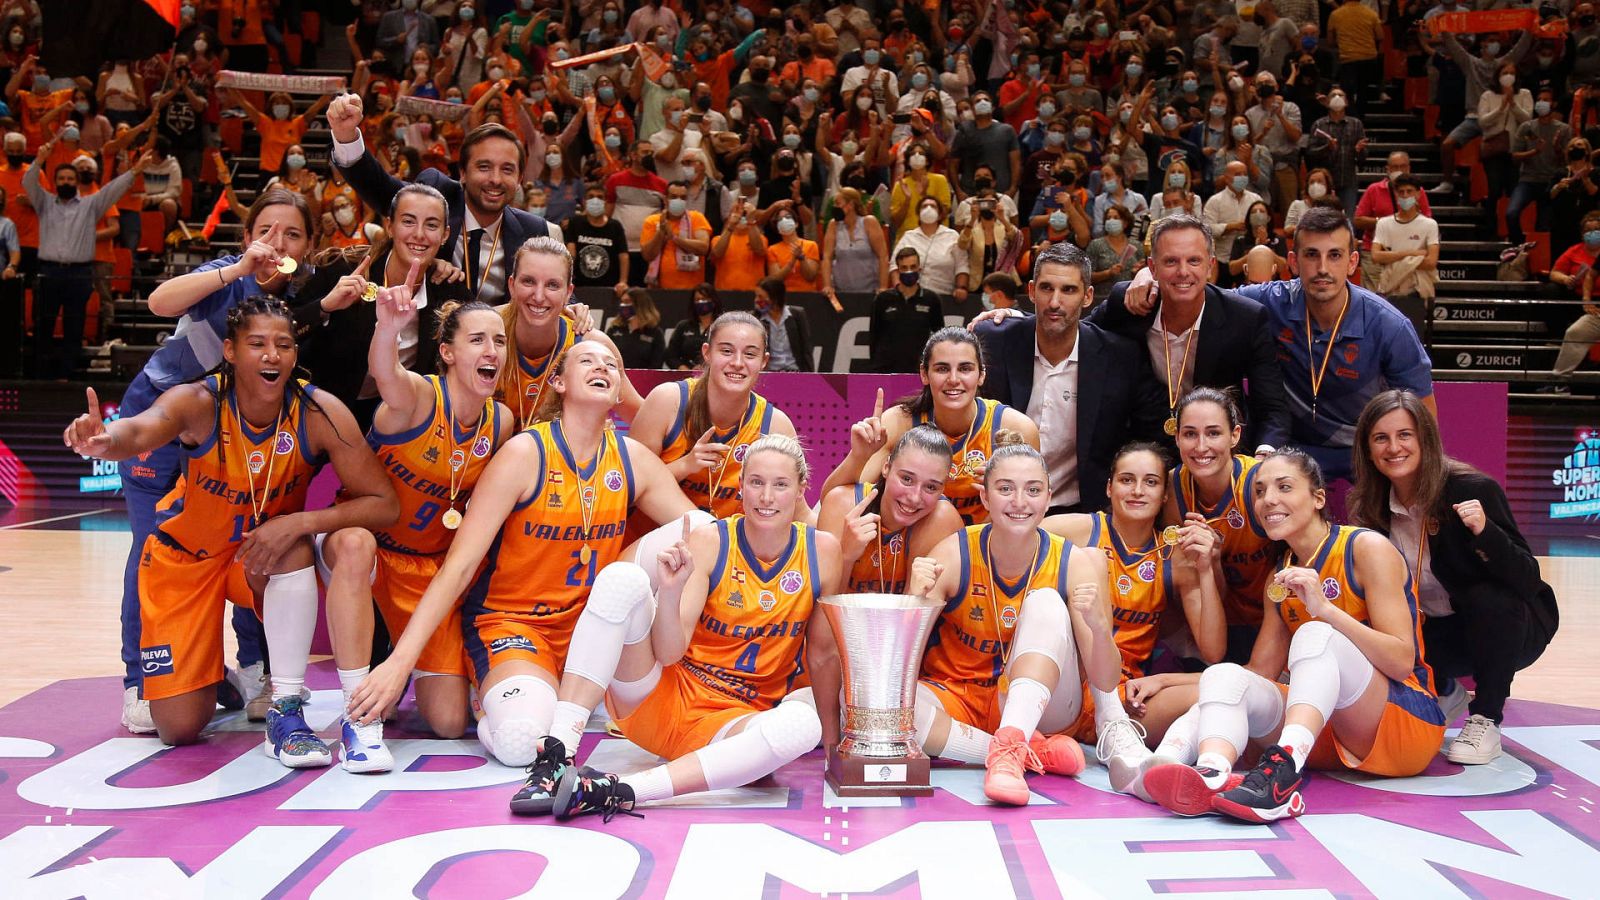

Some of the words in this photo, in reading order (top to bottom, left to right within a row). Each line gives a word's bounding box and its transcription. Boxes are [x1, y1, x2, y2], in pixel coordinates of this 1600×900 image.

[1438, 270, 1466, 279] RICH
[1452, 309, 1495, 319] ZURICH
[1476, 356, 1520, 365] ZURICH
[1564, 483, 1600, 502] WOM
[408, 501, 441, 532] 9
[565, 550, 598, 587] 21
[734, 642, 761, 674] 4
